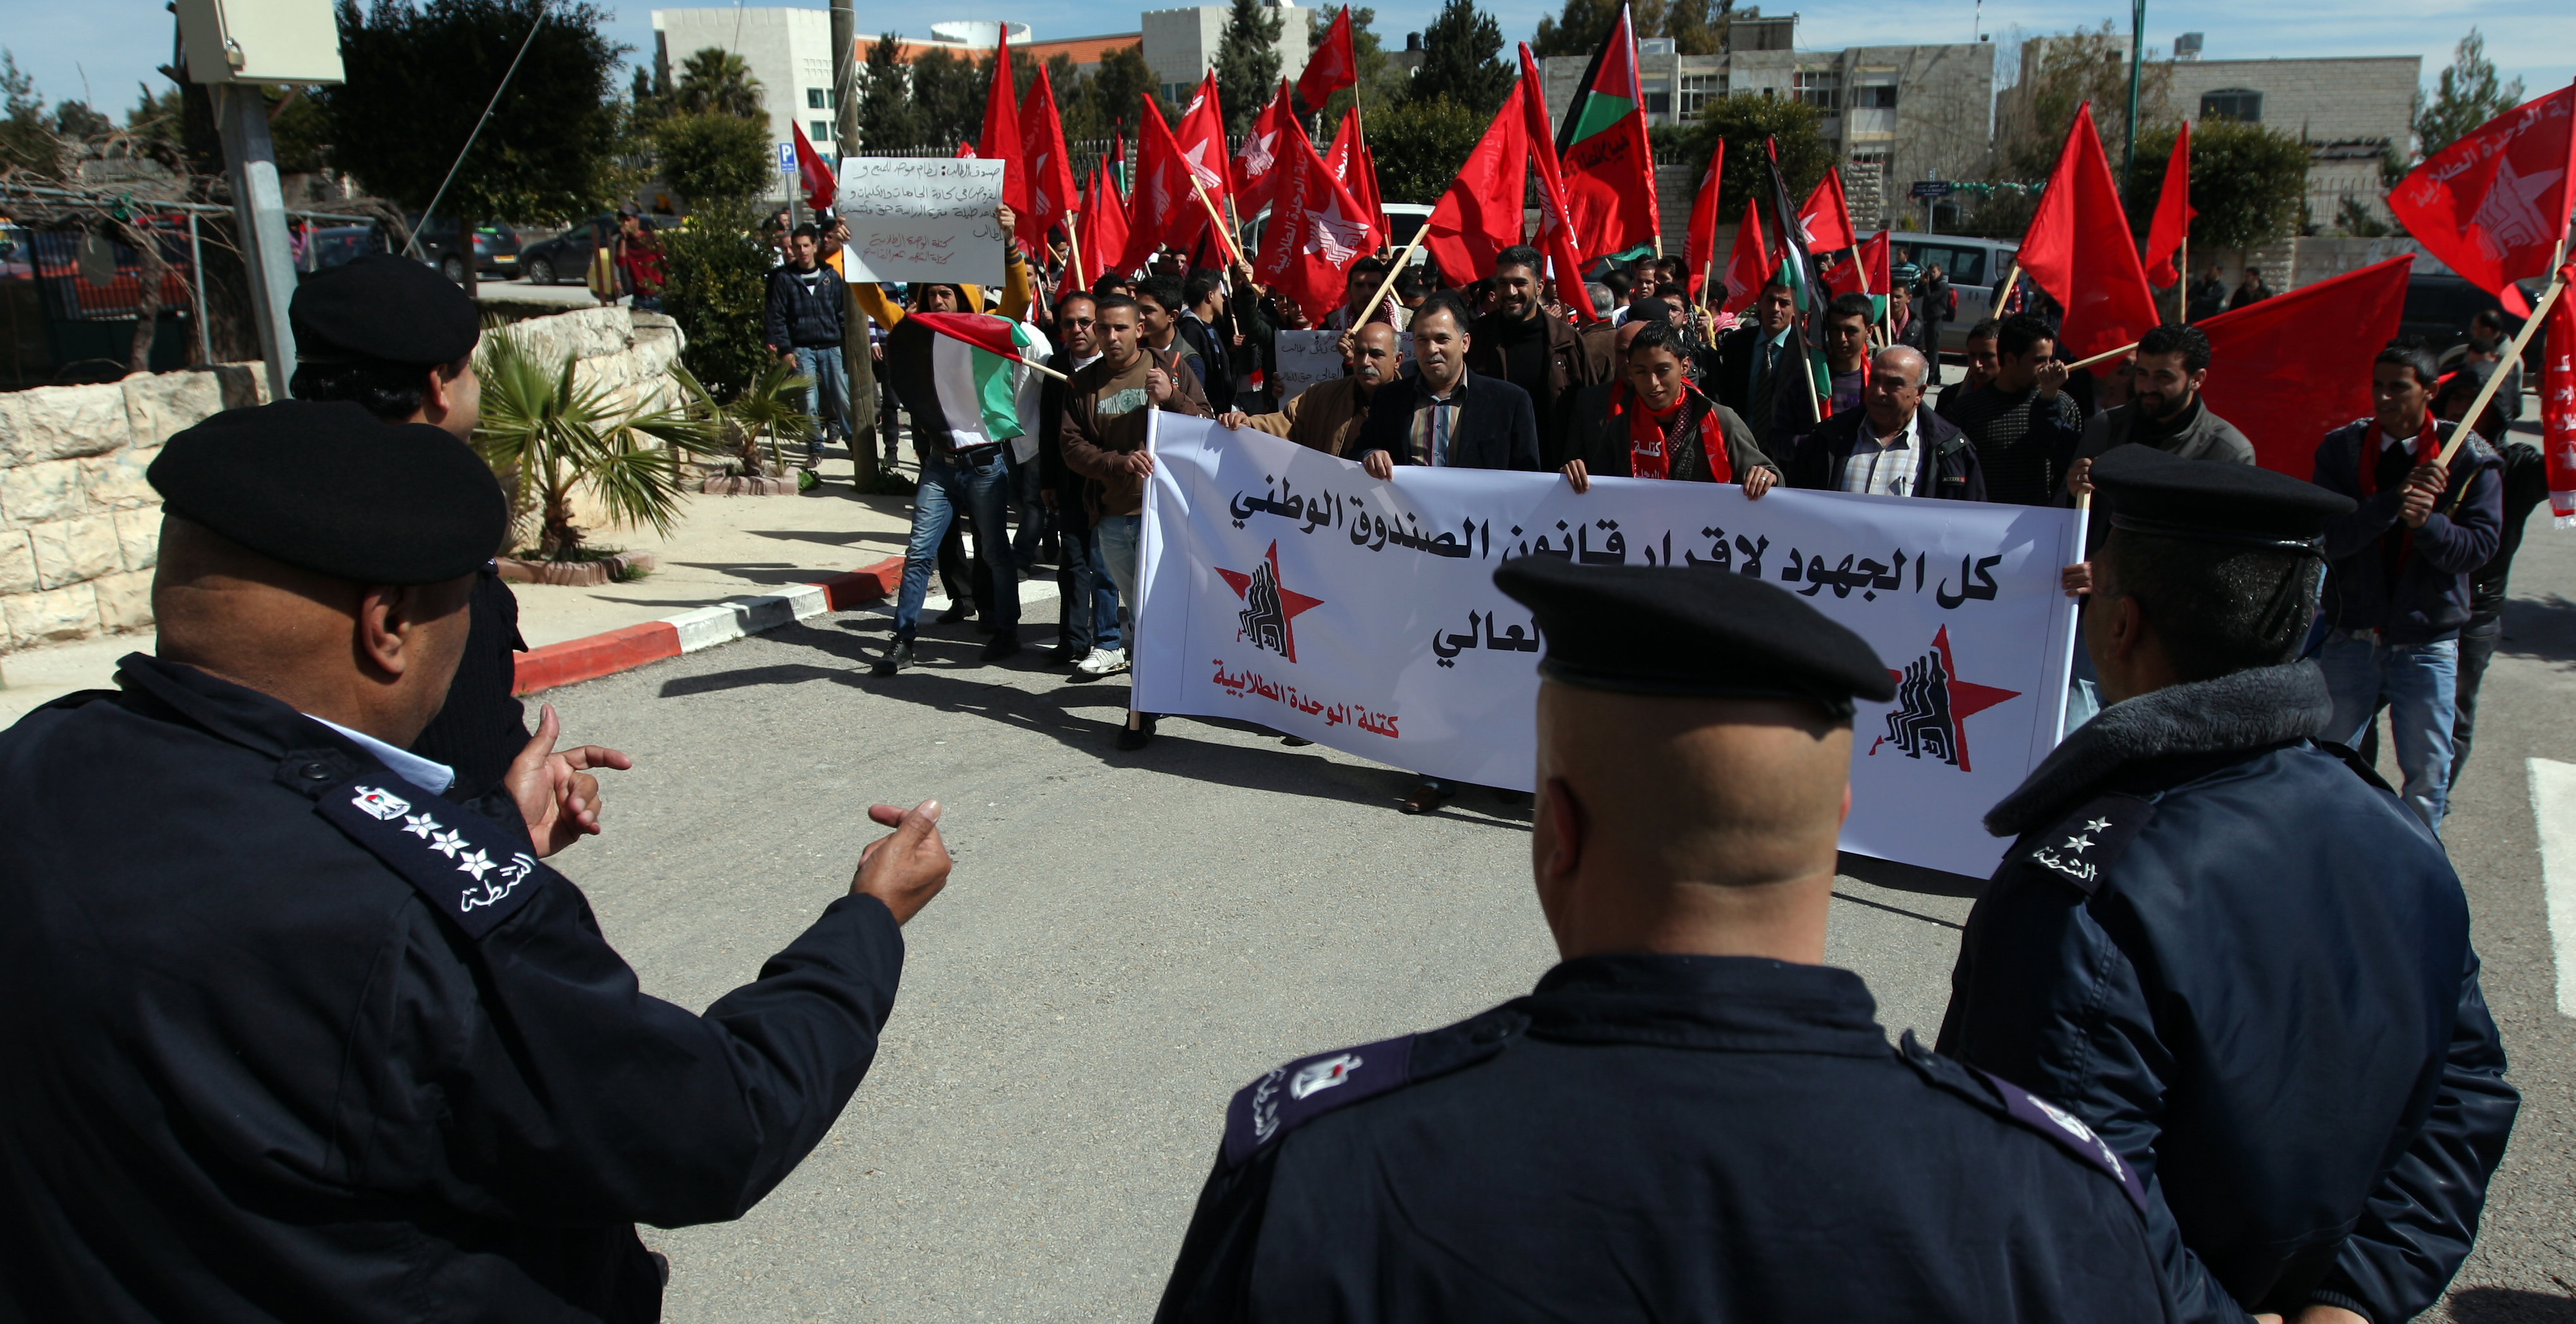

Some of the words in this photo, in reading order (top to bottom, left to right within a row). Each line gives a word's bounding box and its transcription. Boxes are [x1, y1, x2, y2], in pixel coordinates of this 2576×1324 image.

[781, 144, 791, 162] P
[852, 165, 868, 180] و
[917, 162, 937, 180] نظام
[849, 190, 856, 200] و
[893, 185, 928, 200] الجامعات
[955, 185, 967, 202] في
[1286, 176, 1306, 221] الوحدة
[875, 204, 893, 216] حق
[895, 204, 926, 218] الدراسة
[952, 205, 978, 219] طيلة
[931, 235, 955, 248] كتلة
[1268, 221, 1297, 274] الطلابية
[929, 252, 955, 264] كتلة
[1281, 343, 1306, 357] طالب
[1280, 371, 1298, 382] للطال
[1297, 372, 1313, 383] حق
[1634, 440, 1662, 457] كتلة
[1229, 474, 1344, 534] الوطني
[1349, 495, 1490, 561] الصندوق
[1781, 547, 1926, 603] الجهود
[1936, 553, 2003, 610] كل
[1432, 608, 1540, 669] لعالي
[1211, 659, 1285, 704] الطلابية
[1287, 686, 1351, 727] الوحدة
[1354, 704, 1399, 739] كتلة
[2032, 846, 2098, 883] الشرطة
[461, 852, 536, 912] الشرطة
